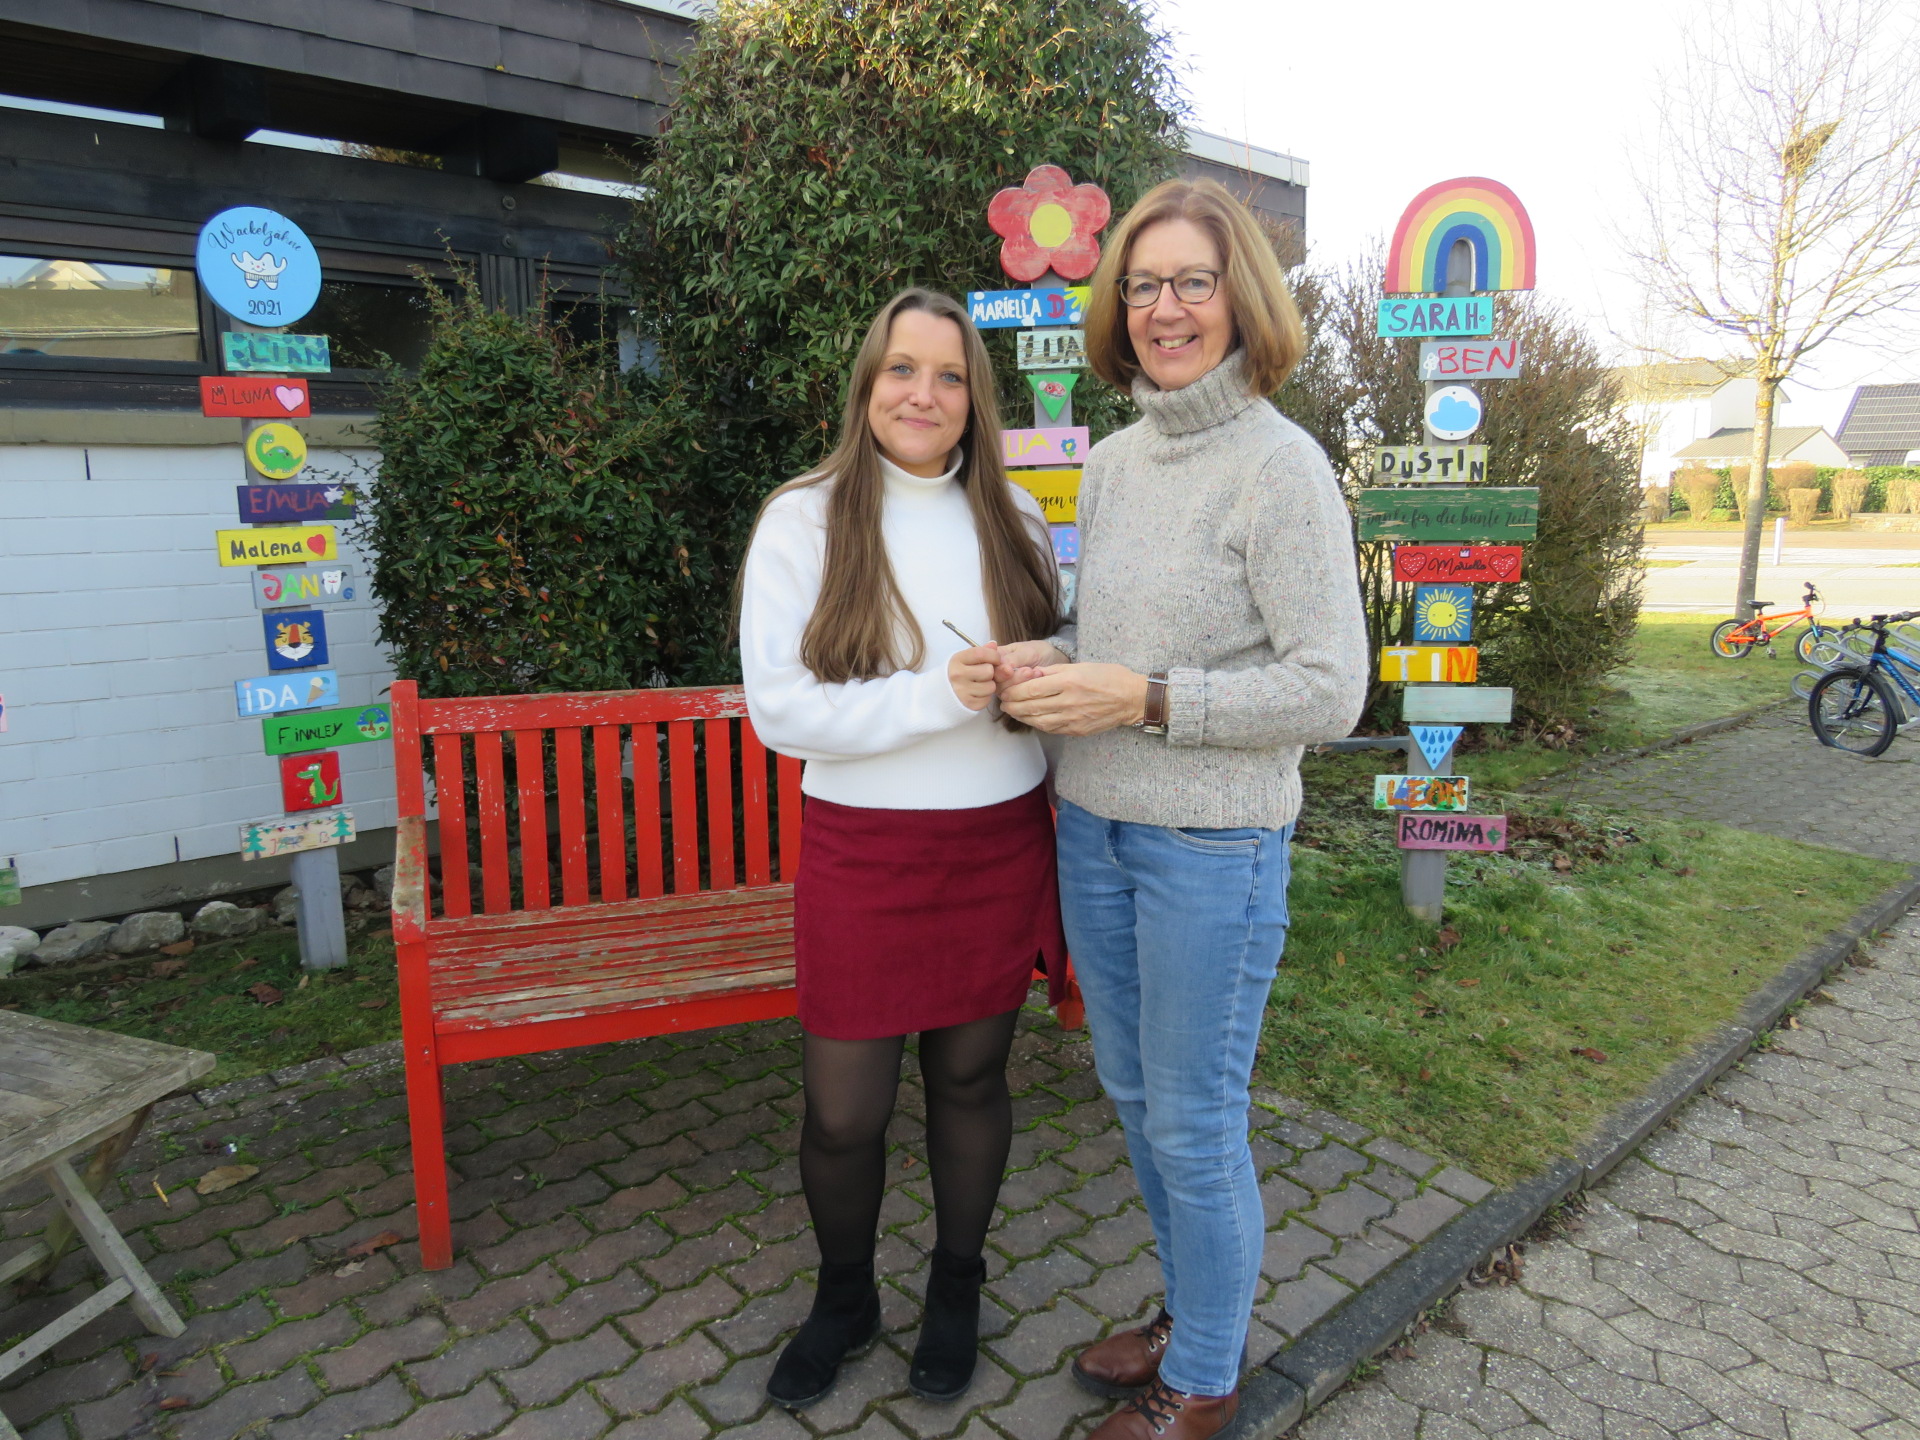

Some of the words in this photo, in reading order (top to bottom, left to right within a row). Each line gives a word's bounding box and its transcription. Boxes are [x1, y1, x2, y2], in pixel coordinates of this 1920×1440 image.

[248, 299, 282, 316] 2021
[1388, 302, 1479, 332] SARAH
[248, 340, 330, 366] LIAM
[1438, 340, 1517, 374] BEN
[231, 386, 272, 405] LUNA
[1436, 506, 1456, 524] die
[1461, 506, 1500, 528] bunte
[231, 539, 303, 560] Malena
[262, 573, 320, 603] JAN
[1387, 648, 1478, 682] TIM
[1387, 779, 1466, 808] LEON
